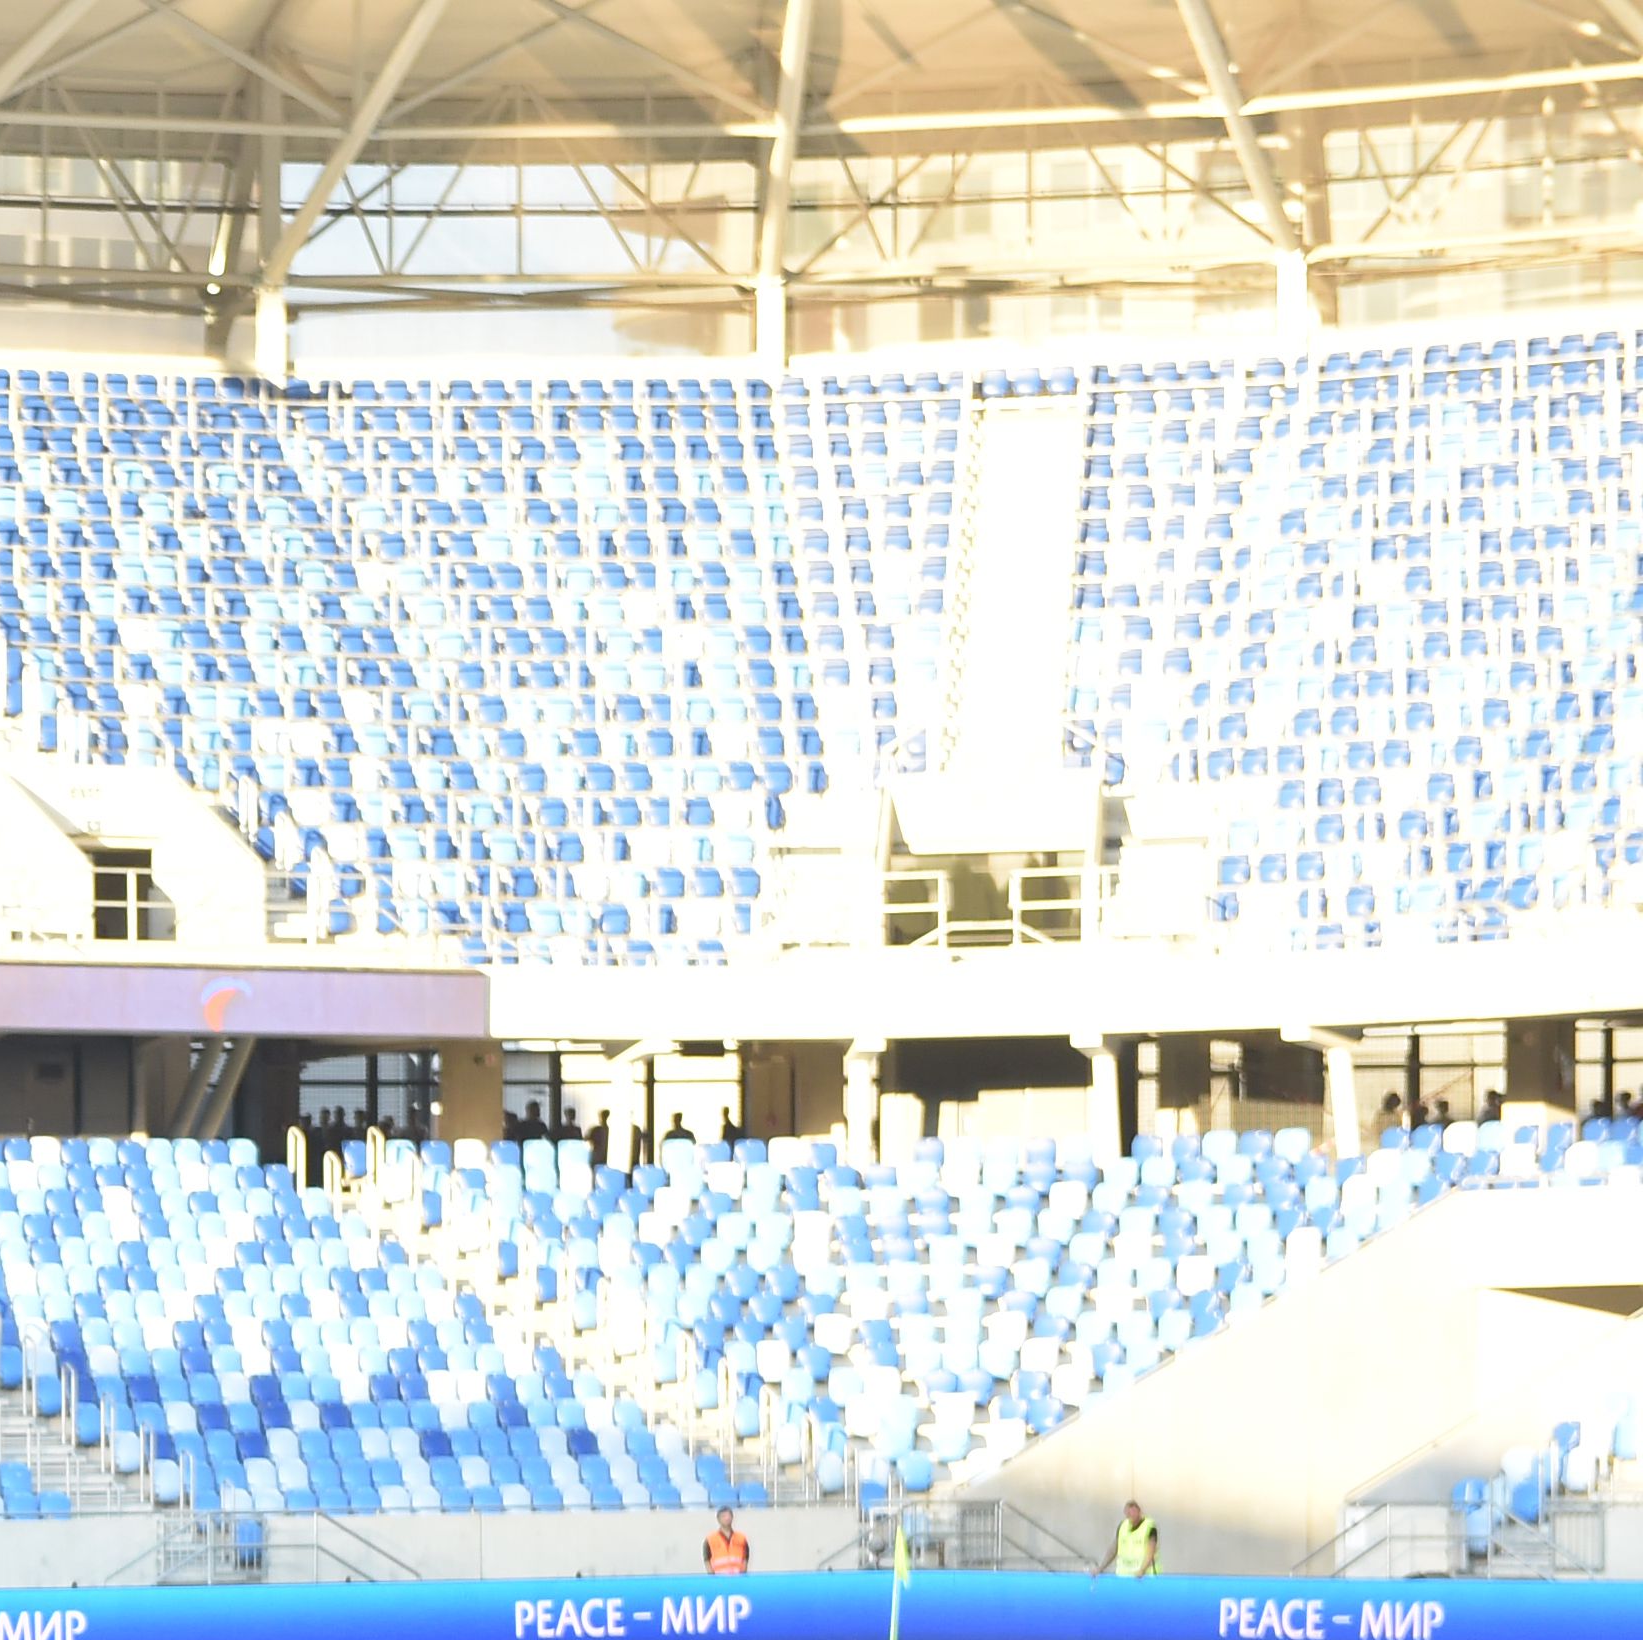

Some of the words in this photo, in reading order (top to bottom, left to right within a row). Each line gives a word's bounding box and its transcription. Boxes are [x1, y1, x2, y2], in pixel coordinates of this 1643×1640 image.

[514, 1597, 625, 1638] PEACE
[661, 1594, 751, 1634] МИР
[1219, 1597, 1324, 1640] PEACE
